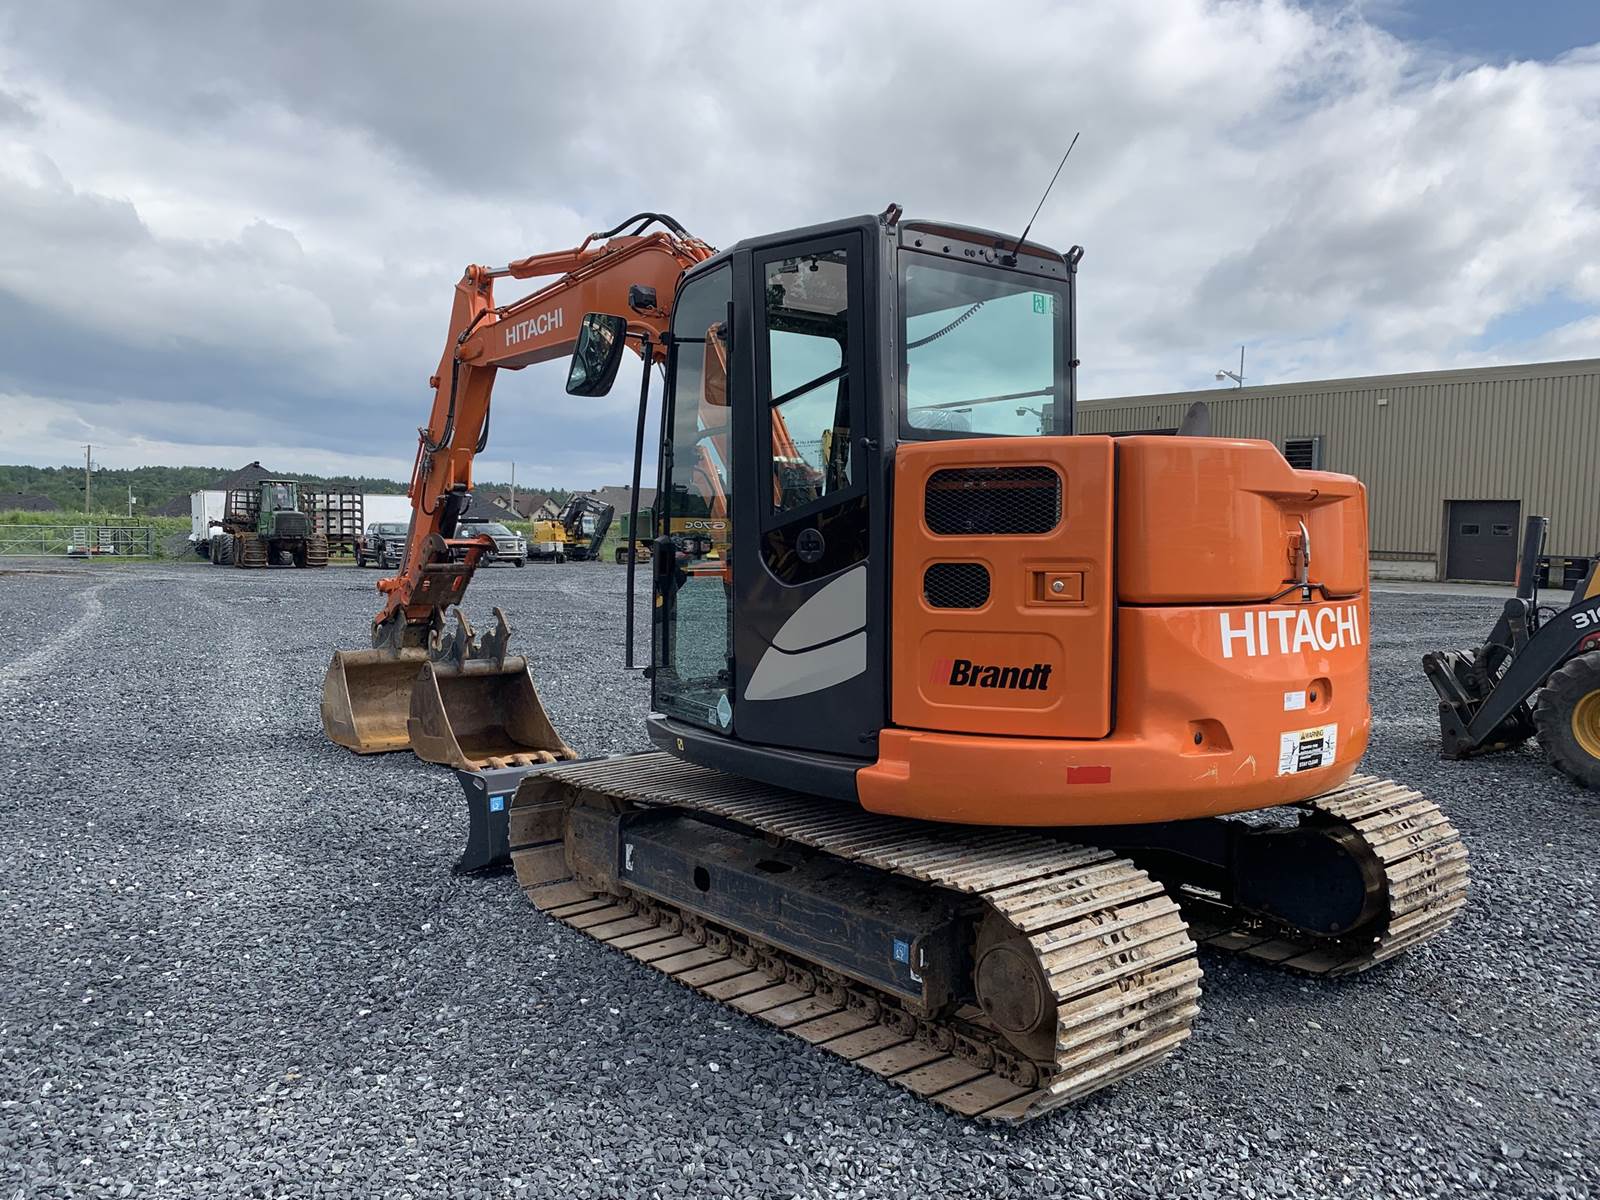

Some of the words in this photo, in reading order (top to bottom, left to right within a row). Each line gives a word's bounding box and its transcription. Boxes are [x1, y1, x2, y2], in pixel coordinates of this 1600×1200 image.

[505, 307, 563, 346] HITACHI
[1220, 605, 1362, 658] HITACHI
[1571, 606, 1600, 629] 31
[949, 659, 1052, 691] Brandt
